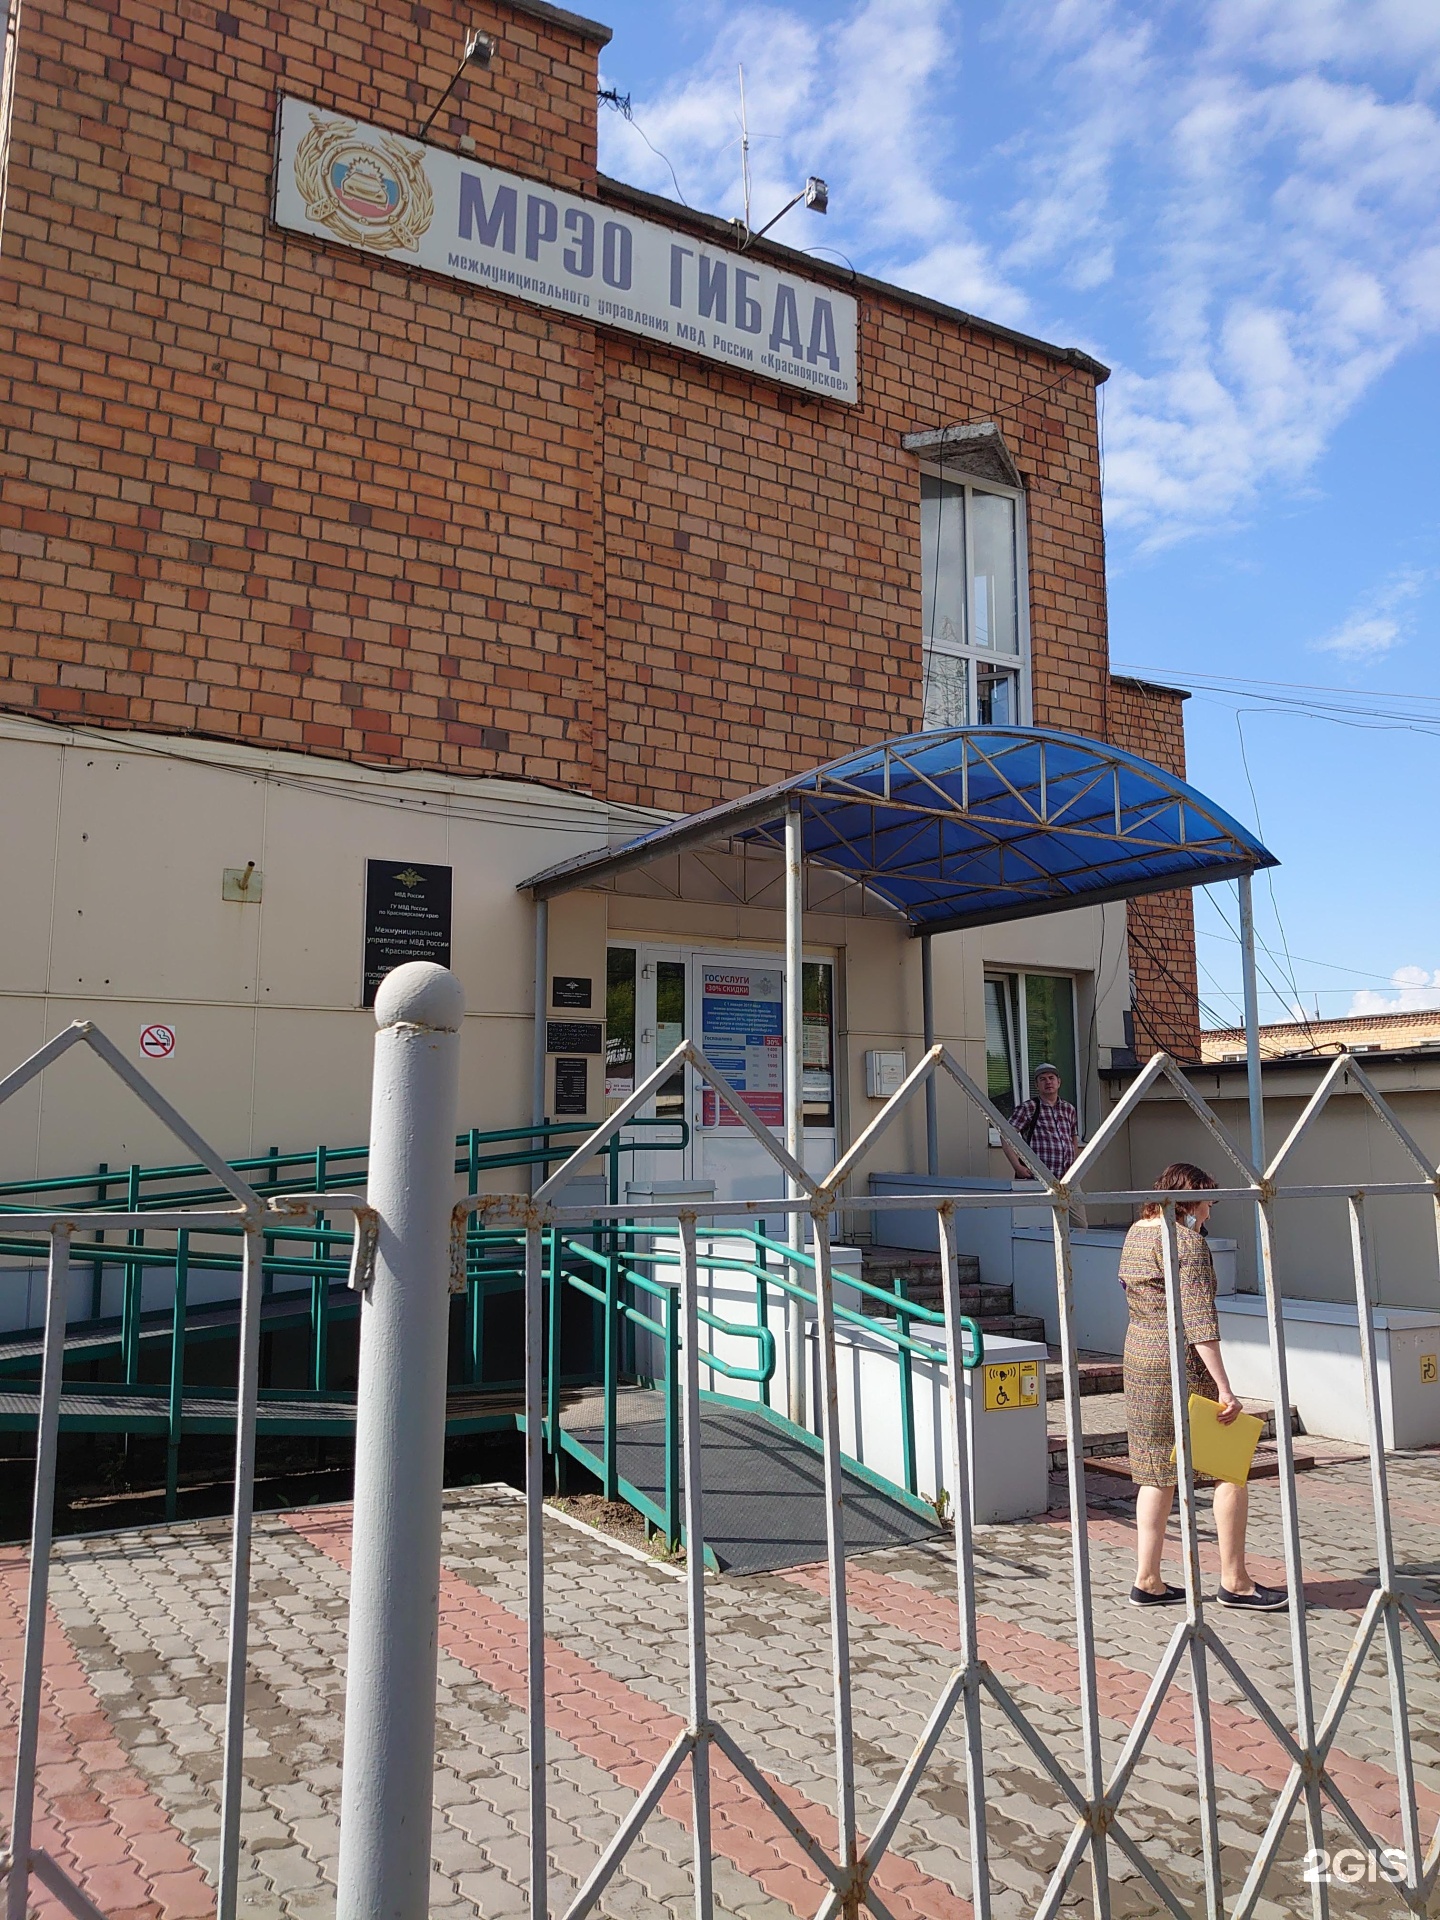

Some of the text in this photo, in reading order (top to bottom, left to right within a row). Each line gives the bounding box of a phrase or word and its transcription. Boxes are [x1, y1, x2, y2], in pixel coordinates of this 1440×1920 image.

[458, 172, 839, 372] МРЭО ГИБДД
[448, 252, 849, 391] межмуниципального управления МВД России «Красноярское»
[374, 926, 443, 937] Межмуниципальное
[367, 937, 407, 945] управление
[704, 974, 749, 984] ГОСУСЛУГИ
[722, 986, 749, 994] СКИДКИ
